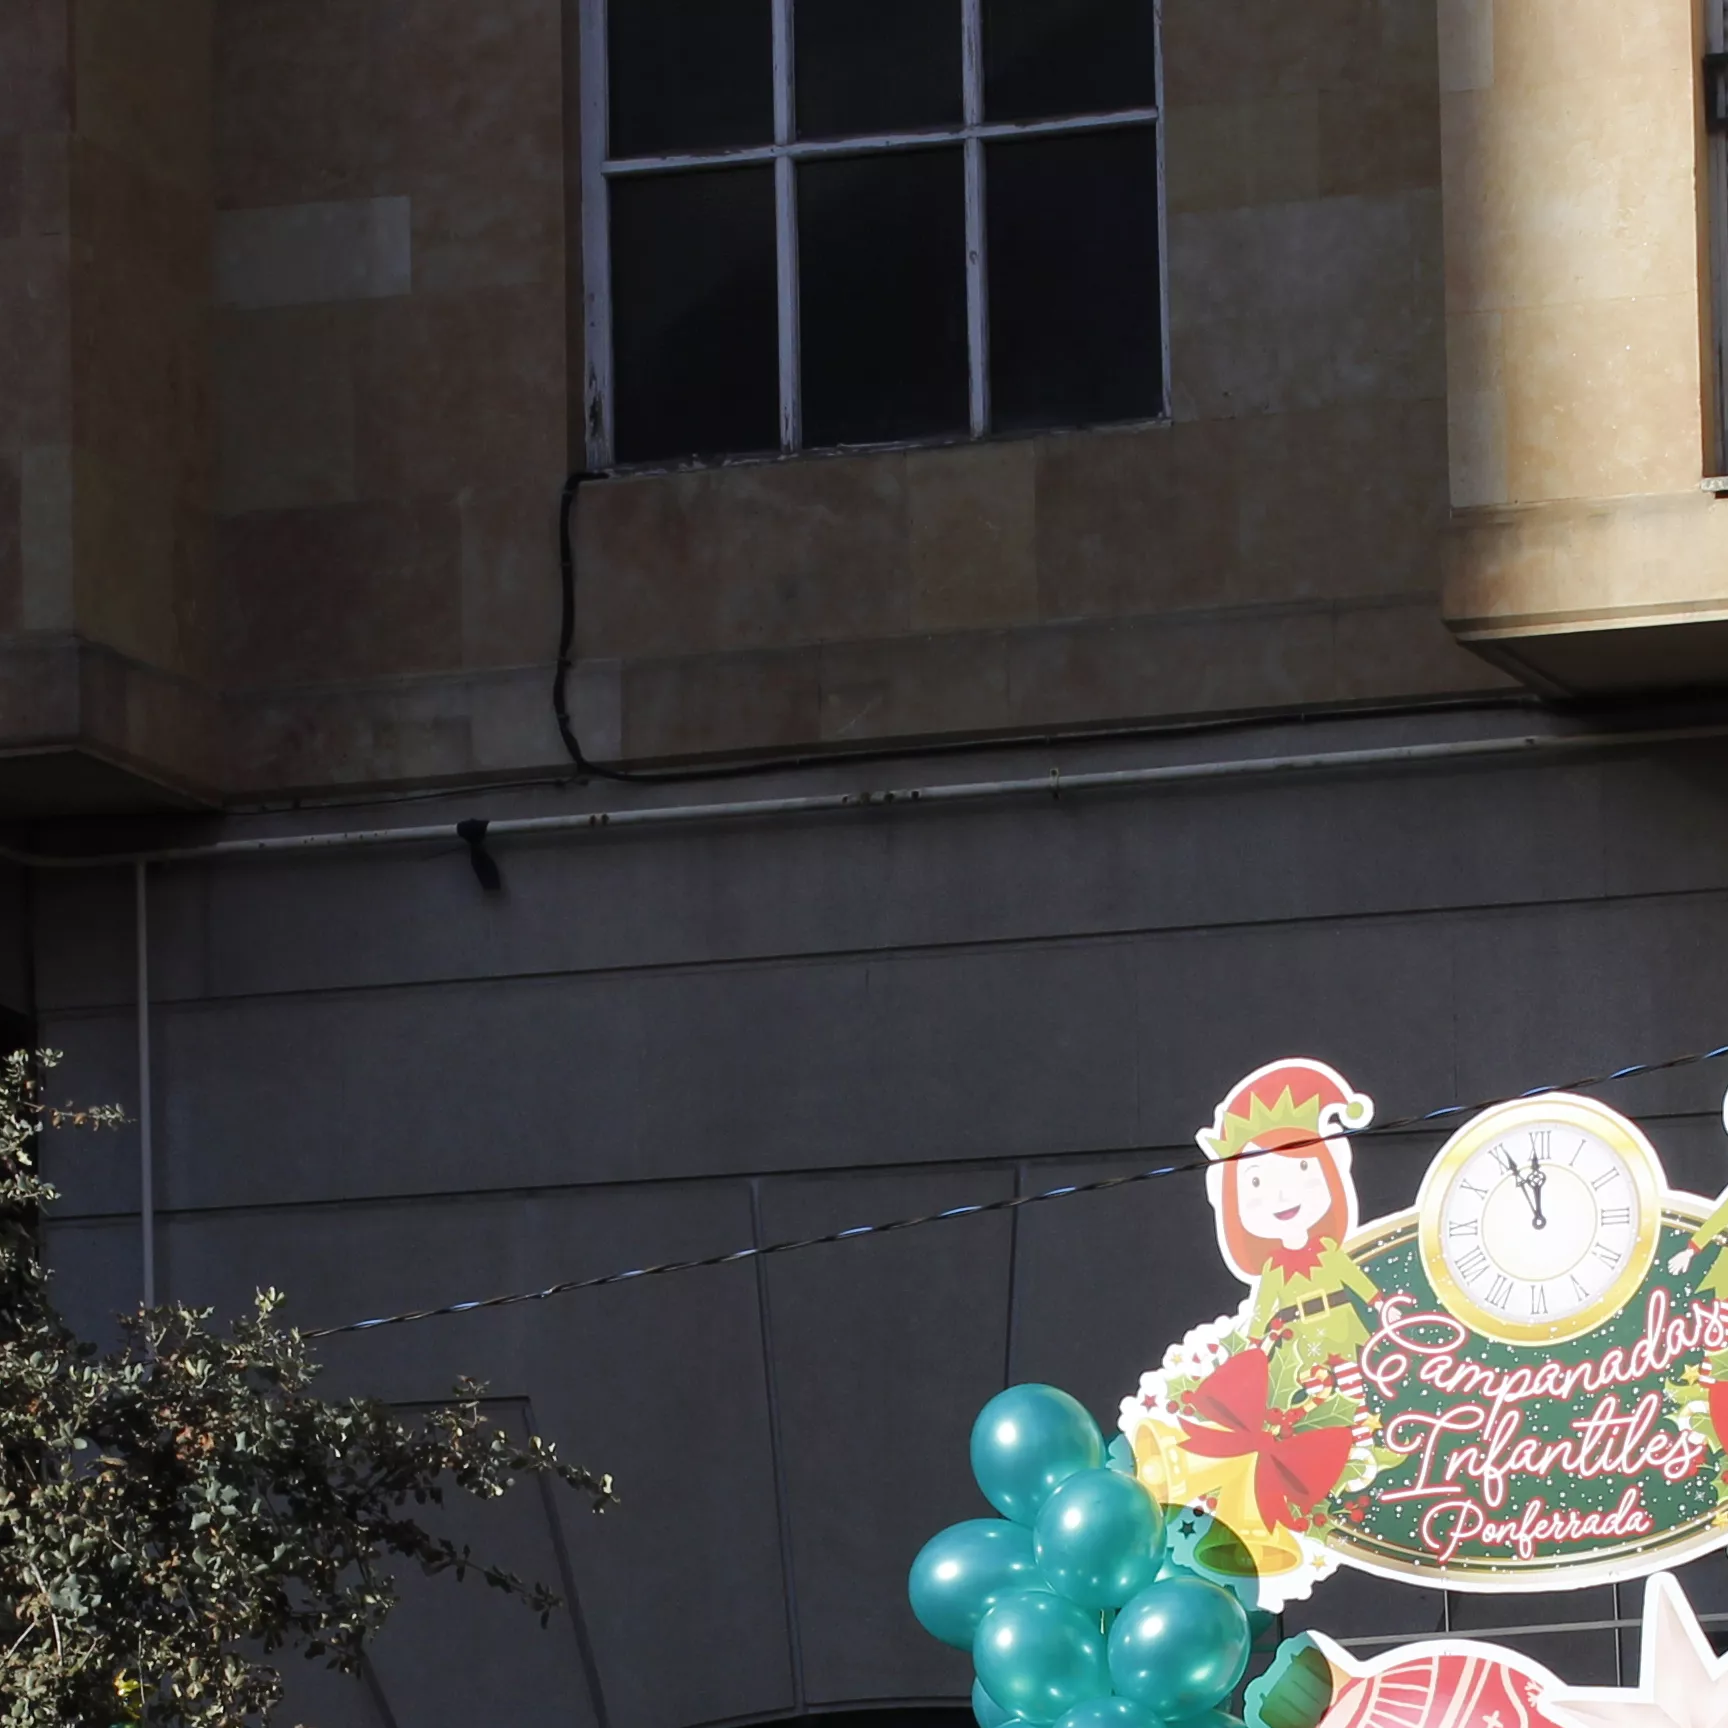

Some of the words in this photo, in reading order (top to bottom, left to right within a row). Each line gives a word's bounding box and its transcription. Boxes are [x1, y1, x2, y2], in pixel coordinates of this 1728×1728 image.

[1528, 1130, 1552, 1161] XII
[1361, 1290, 1727, 1441] Campanadas
[1382, 1394, 1704, 1507] Infantiles
[1422, 1488, 1650, 1562] Ponferrada
